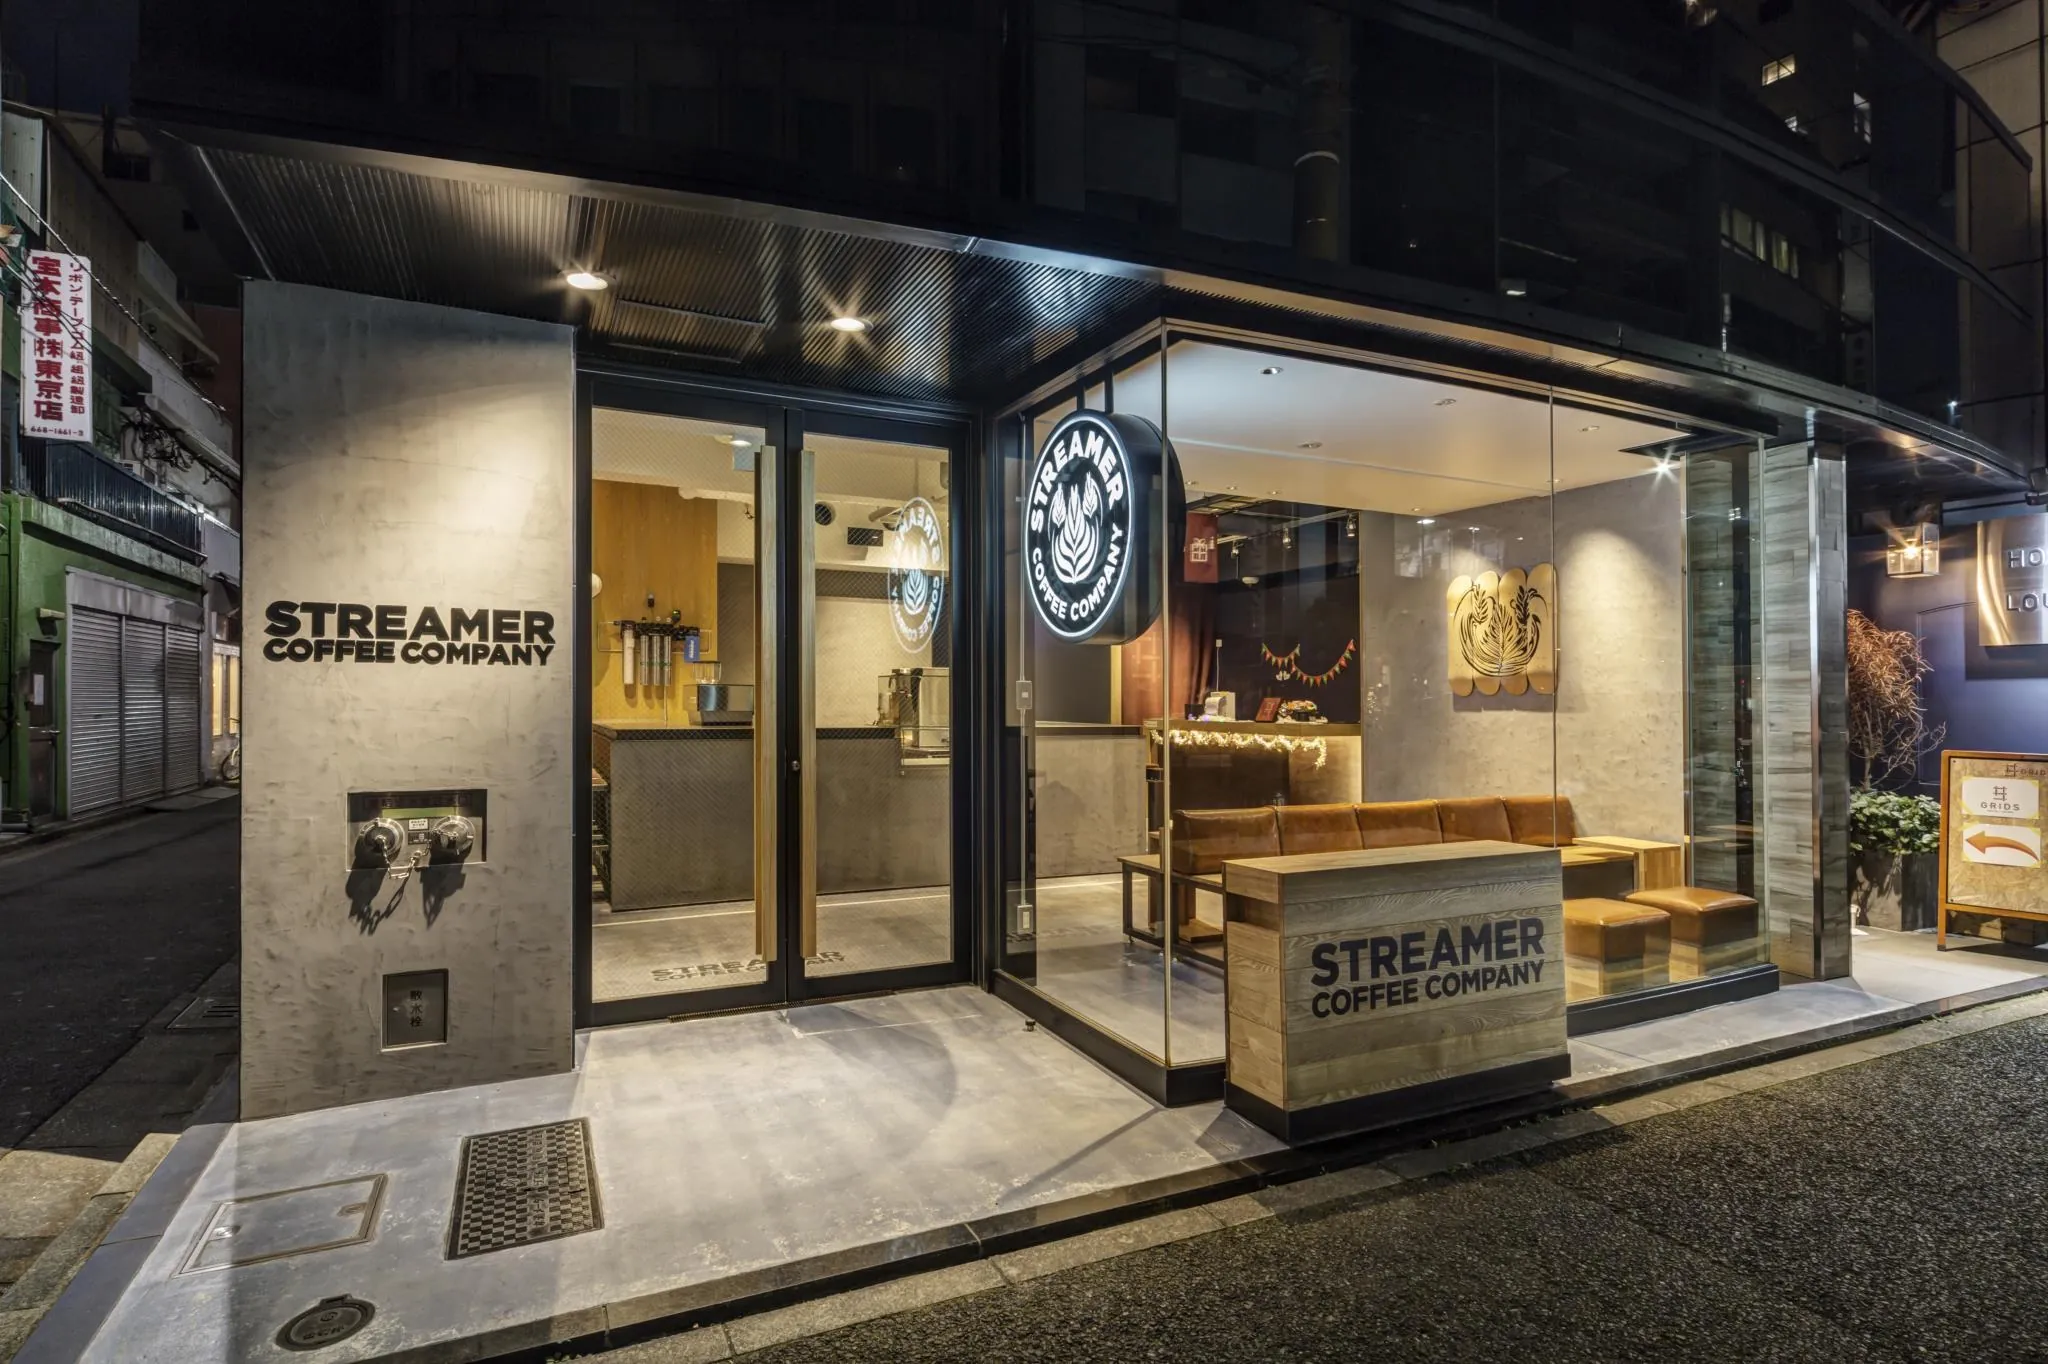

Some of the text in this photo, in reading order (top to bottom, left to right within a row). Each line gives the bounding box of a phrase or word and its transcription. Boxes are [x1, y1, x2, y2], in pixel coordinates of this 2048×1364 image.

[1030, 430, 1124, 534] STREAMER
[1032, 522, 1123, 622] COFFEE COMPANY
[263, 638, 554, 666] COFFEE COMPANY
[264, 600, 556, 644] STREAMER
[1311, 917, 1545, 986] STREAMER
[1312, 960, 1544, 1018] COFFEE COMPANY
